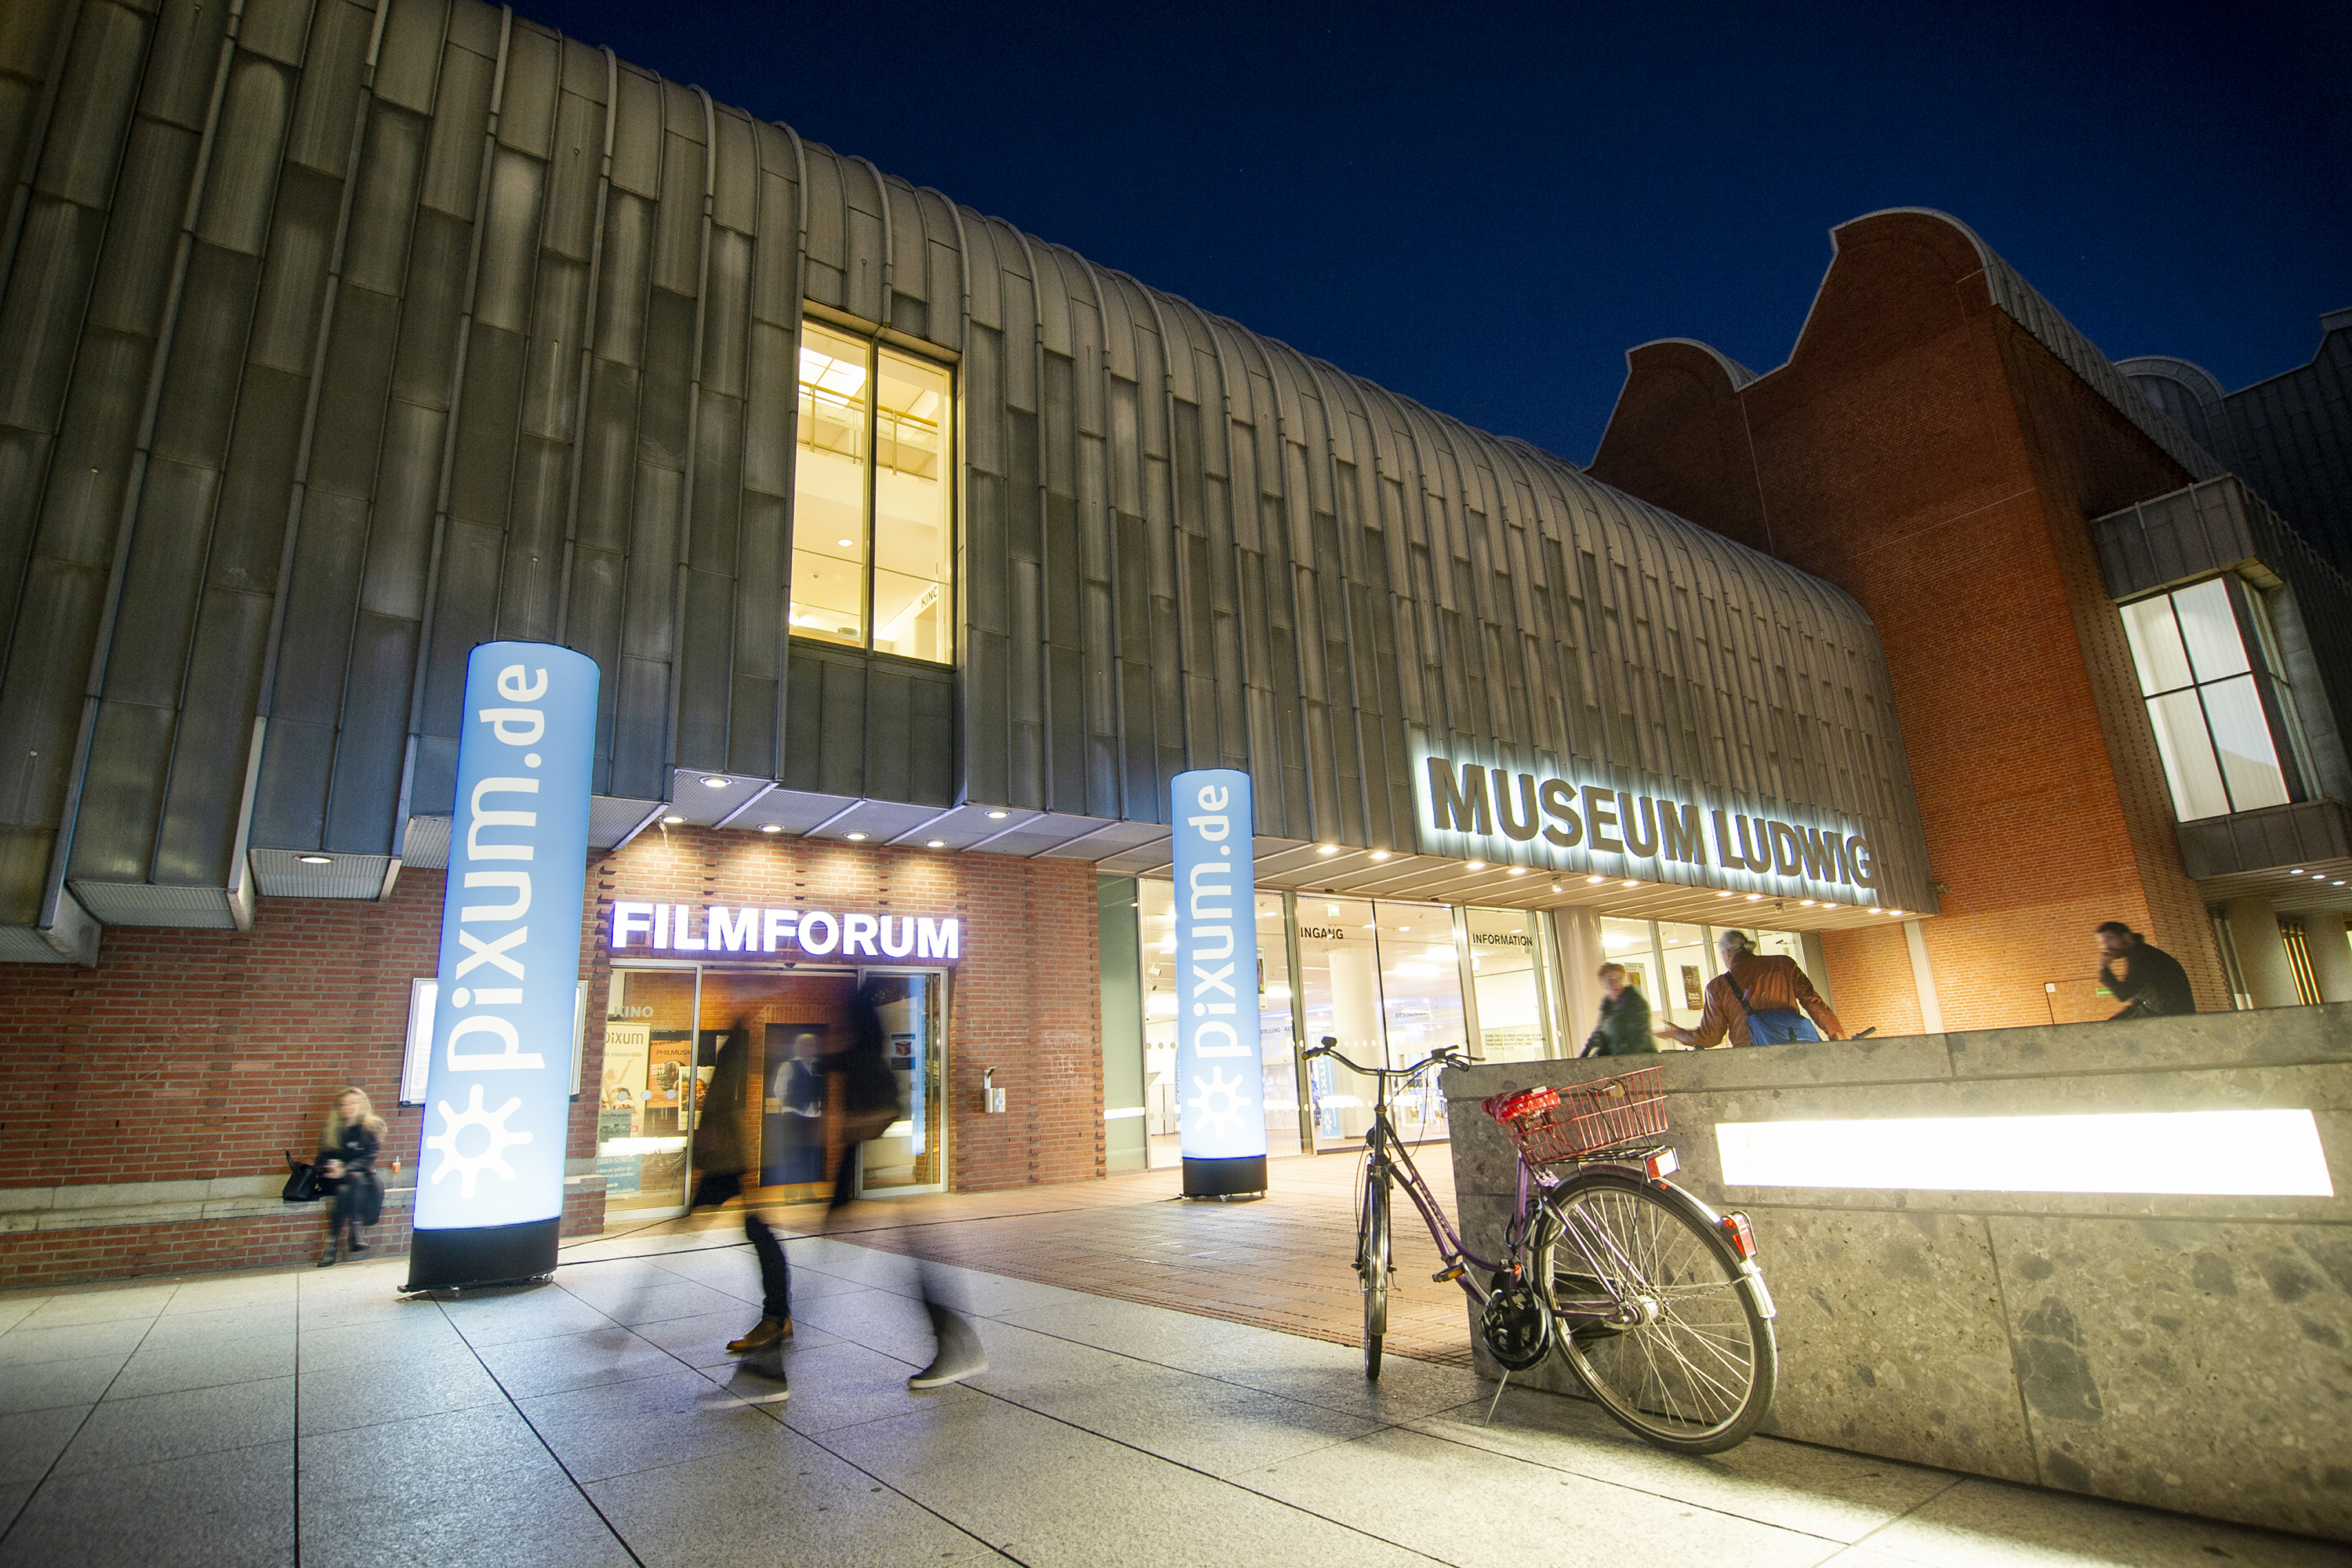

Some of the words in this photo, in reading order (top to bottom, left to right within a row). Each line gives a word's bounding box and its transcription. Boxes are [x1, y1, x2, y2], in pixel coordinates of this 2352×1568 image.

[447, 664, 548, 1072] pixum.de
[1427, 757, 1706, 865] MUSEUM
[1711, 808, 1875, 889] LUDWIG
[612, 902, 959, 959] FILMFORUM
[1188, 785, 1253, 1058] pixum.de
[1472, 933, 1533, 946] INFORMATION
[614, 1006, 654, 1018] KINO
